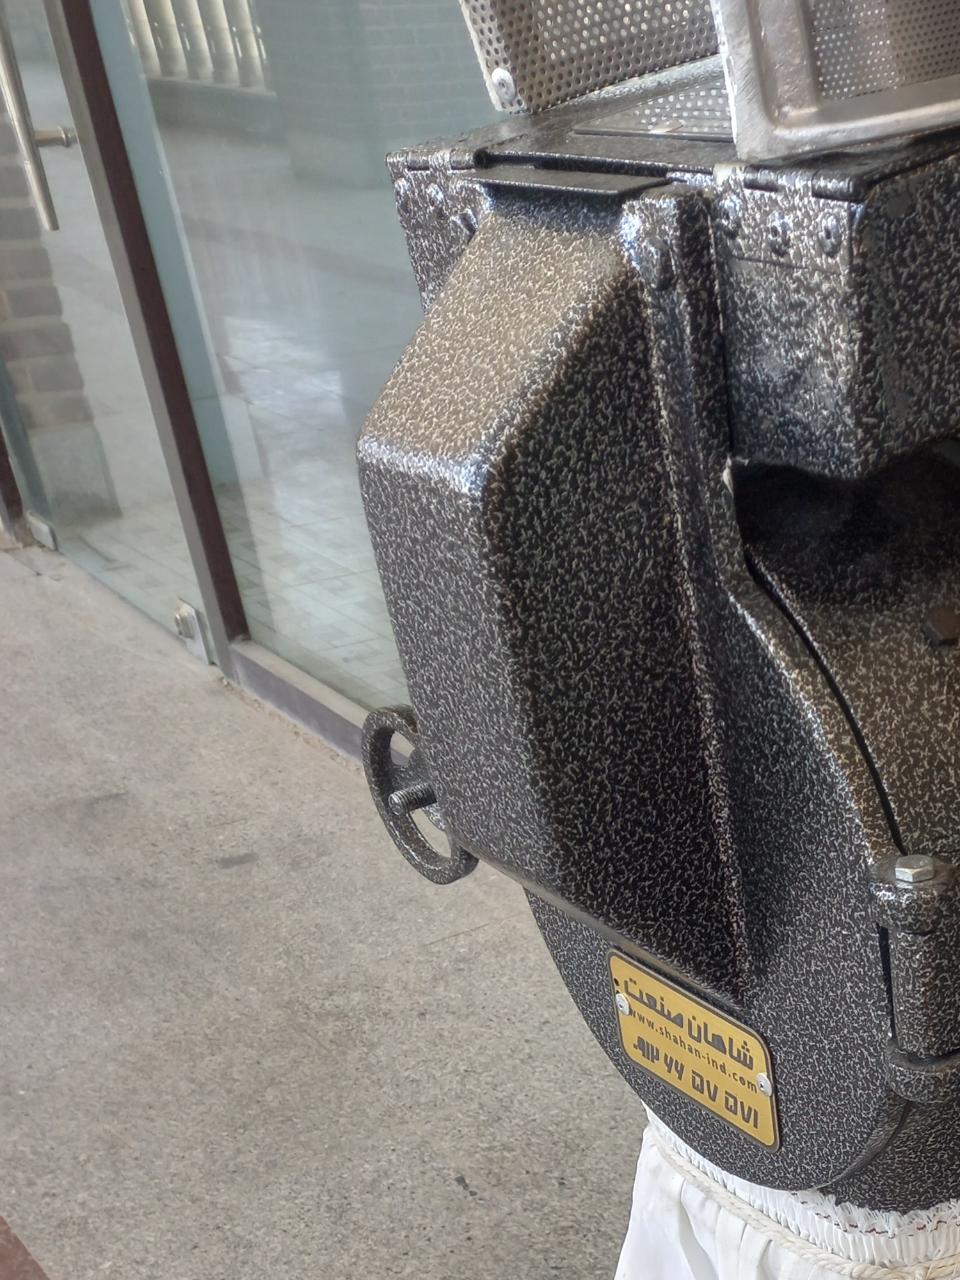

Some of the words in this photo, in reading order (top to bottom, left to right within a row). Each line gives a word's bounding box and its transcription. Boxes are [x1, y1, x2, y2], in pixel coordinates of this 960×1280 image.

[623, 978, 684, 1028] صنعت
[628, 1008, 758, 1094] www.shahan-ind.com
[688, 1015, 753, 1070] شاهان
